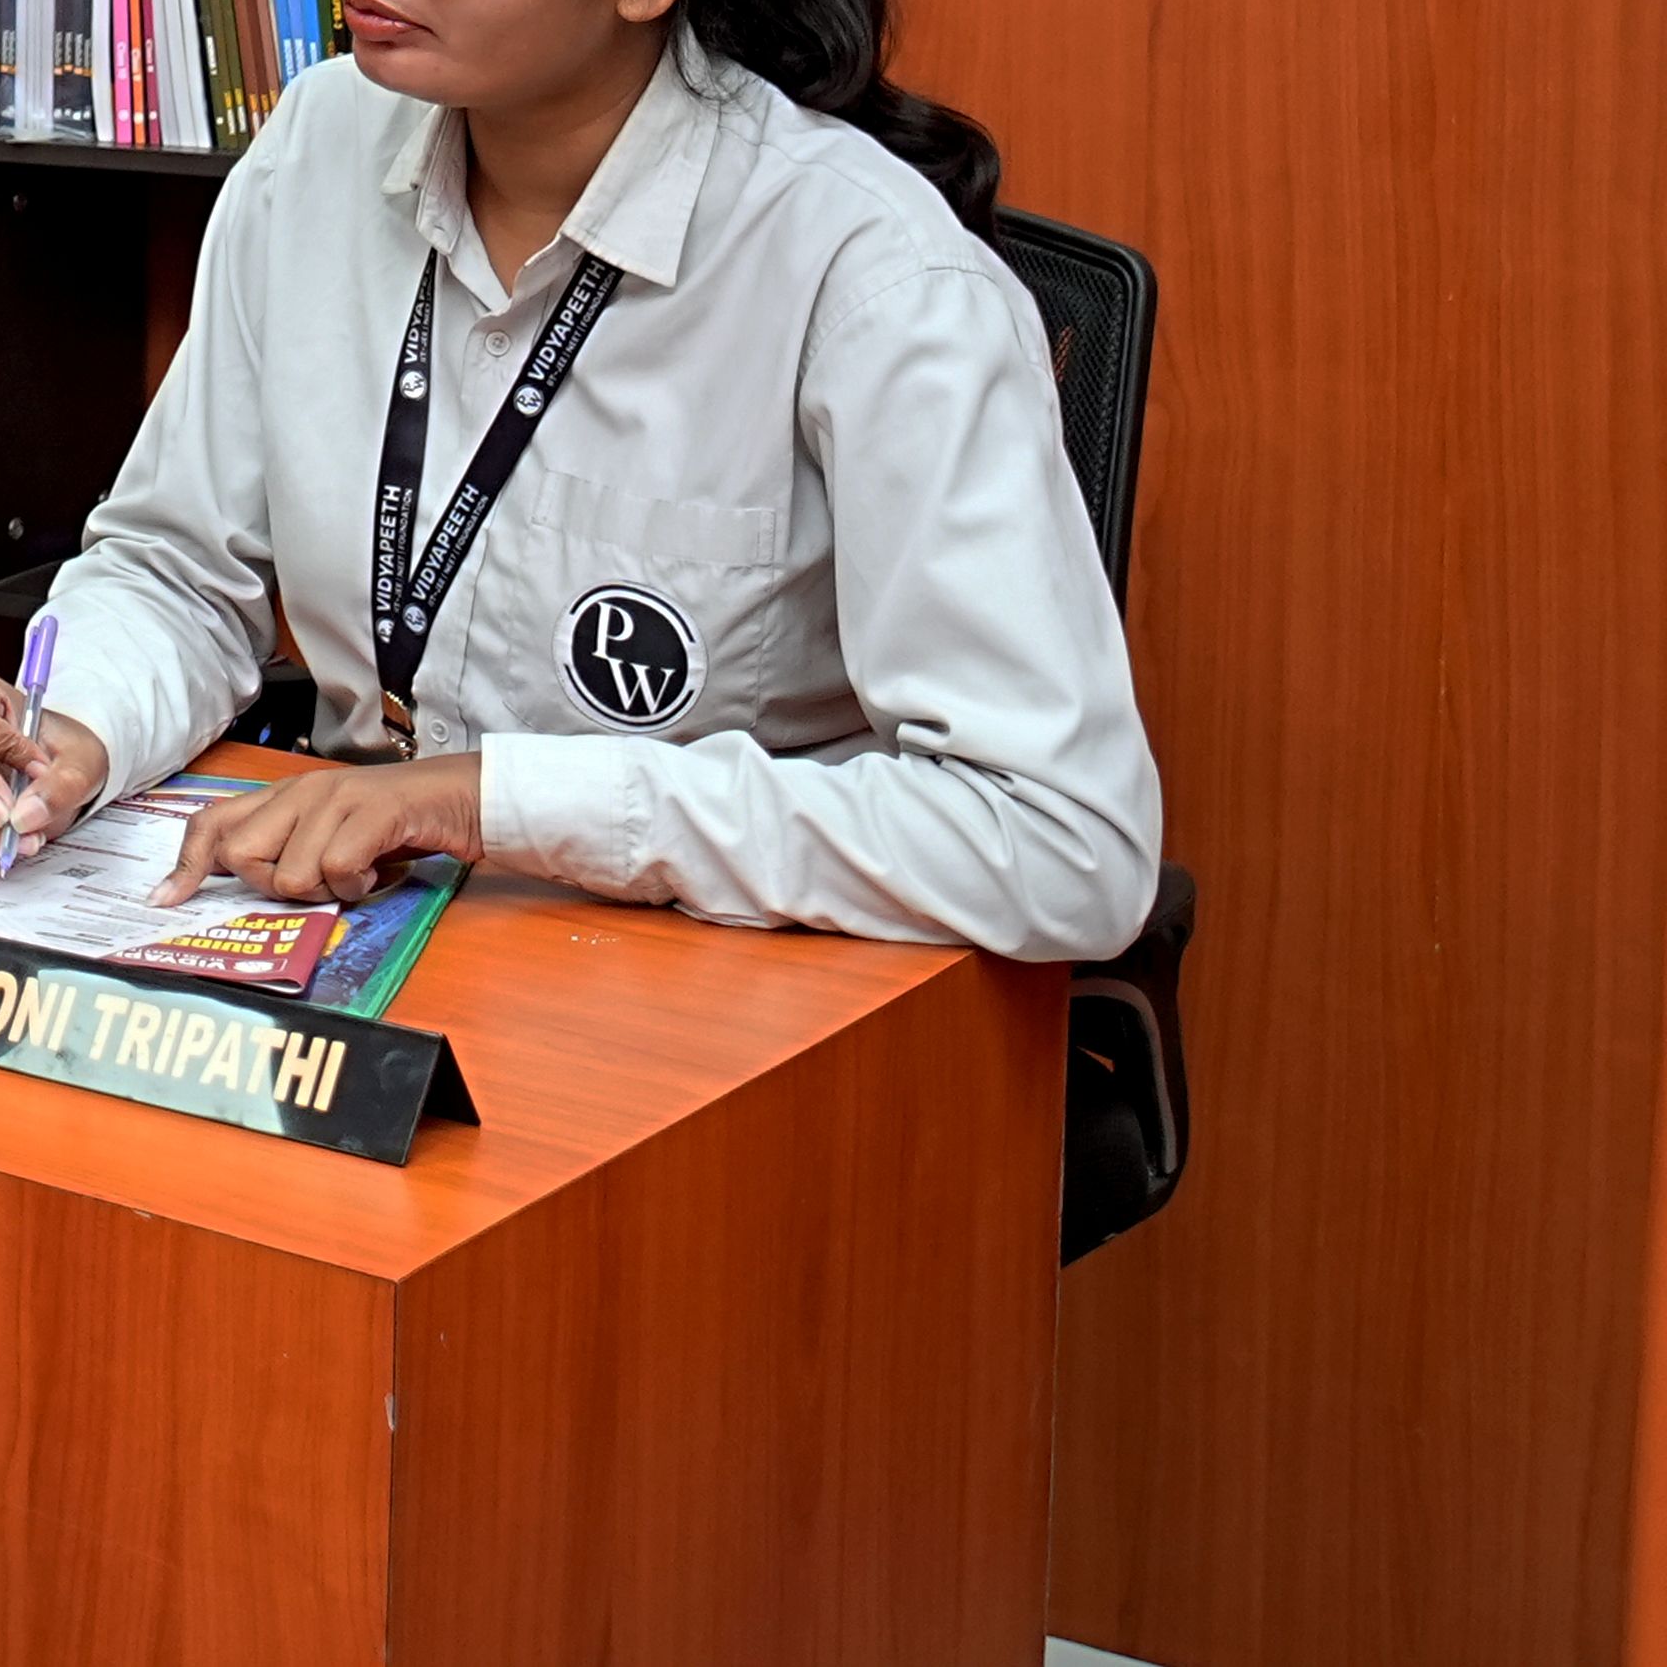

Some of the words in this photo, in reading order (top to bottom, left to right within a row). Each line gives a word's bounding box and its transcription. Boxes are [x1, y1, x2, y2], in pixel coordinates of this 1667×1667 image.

[528, 259, 605, 382] VIDYAPEETH
[580, 270, 618, 327] FOUNDATION
[397, 488, 413, 551] FOUNDATION
[411, 483, 480, 602] VIDYAPEETH
[454, 494, 490, 550] FOUNDATION
[376, 484, 401, 612] VIDYAPEETH
[592, 601, 676, 715] PW
[155, 937, 264, 954] GUIDE
[189, 927, 270, 942] PROV
[225, 916, 307, 931] APPR
[273, 941, 294, 954] A
[278, 930, 301, 942] A
[113, 950, 226, 971] VIDYAP
[90, 992, 348, 1115] TRIPATHI
